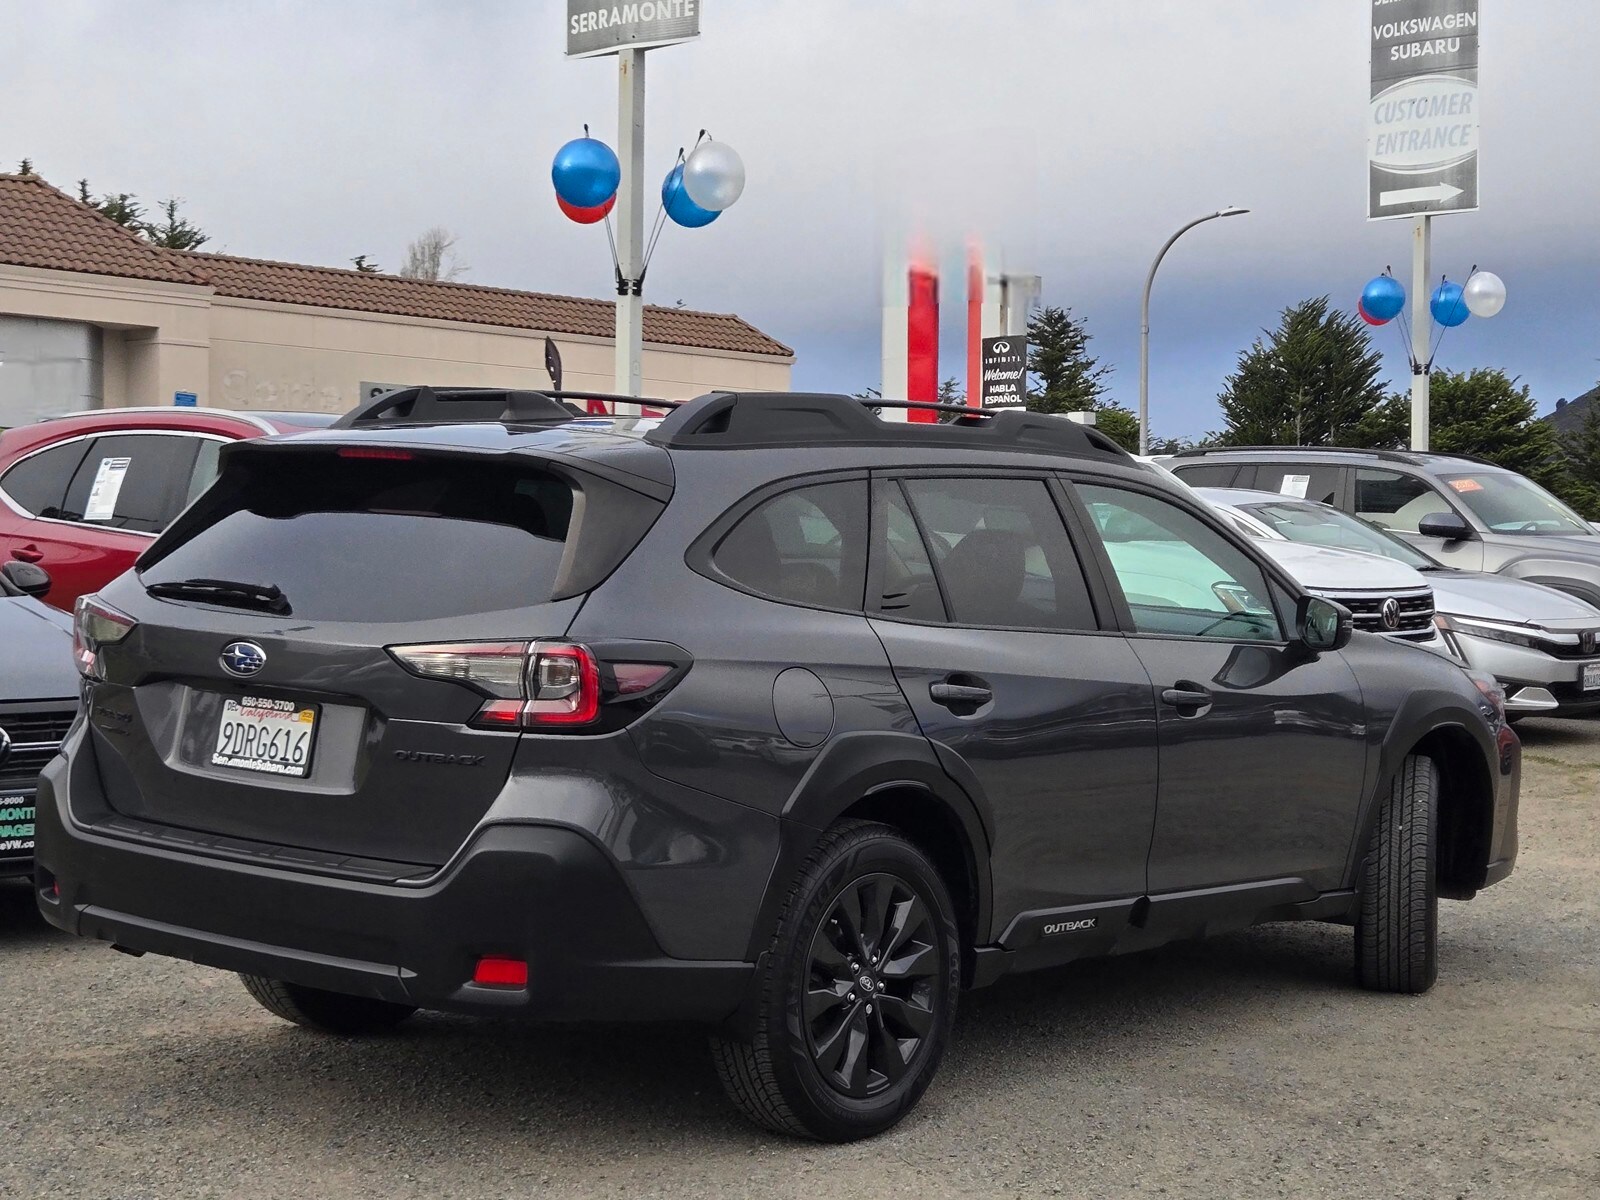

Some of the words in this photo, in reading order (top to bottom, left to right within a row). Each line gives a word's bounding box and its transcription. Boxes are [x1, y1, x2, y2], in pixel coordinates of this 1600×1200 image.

[571, 0, 695, 35] SERRAMONTE
[1373, 11, 1477, 40] VOLKSWAGEN
[1390, 37, 1460, 61] SUBARU
[1374, 91, 1474, 125] CUSTOMER
[1375, 124, 1472, 156] ENTRANCE
[984, 367, 1024, 381] Welcome!
[989, 383, 1017, 393] HABLA
[984, 393, 1022, 405] ESPAÑOL
[241, 696, 295, 711] 650-550-3700
[220, 721, 308, 763] 9DRG616
[395, 749, 486, 767] OUTBACK
[1043, 918, 1096, 934] OUTBACK
